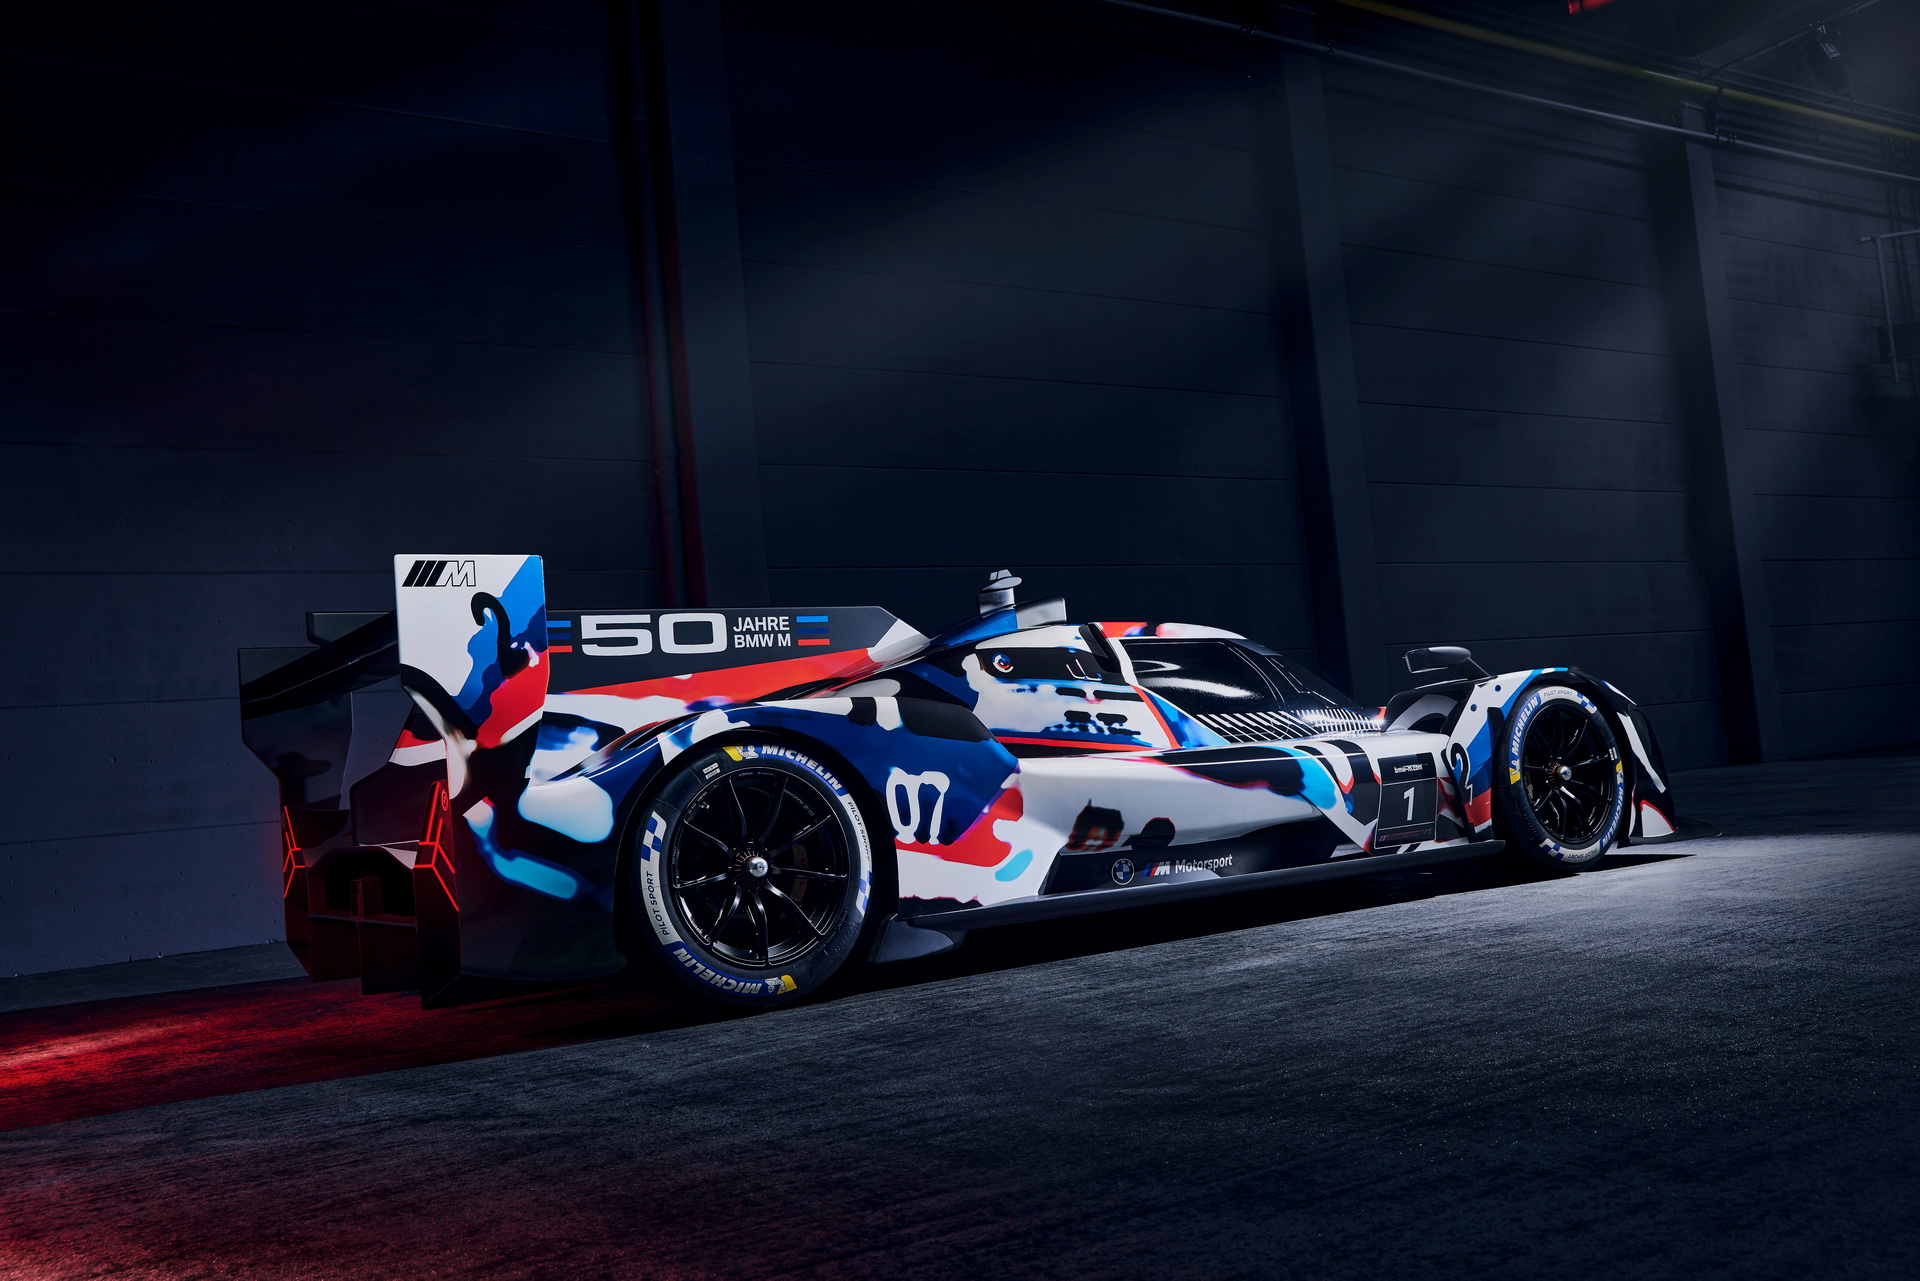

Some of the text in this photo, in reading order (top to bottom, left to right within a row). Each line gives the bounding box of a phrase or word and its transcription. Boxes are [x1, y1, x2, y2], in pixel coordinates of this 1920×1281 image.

[434, 560, 476, 587] M
[581, 613, 728, 656] 50
[733, 616, 790, 632] JAHRE
[734, 633, 791, 648] BMW M
[1511, 696, 1539, 756] MICHELIN
[761, 744, 843, 791] MICHELIN
[847, 801, 863, 827] PILOT
[1403, 786, 1415, 821] 1
[1602, 786, 1624, 847] MICHELIN
[1175, 854, 1233, 874] Motorsport
[646, 871, 670, 936] PILOT SPORT
[673, 948, 762, 994] MICHELIN
